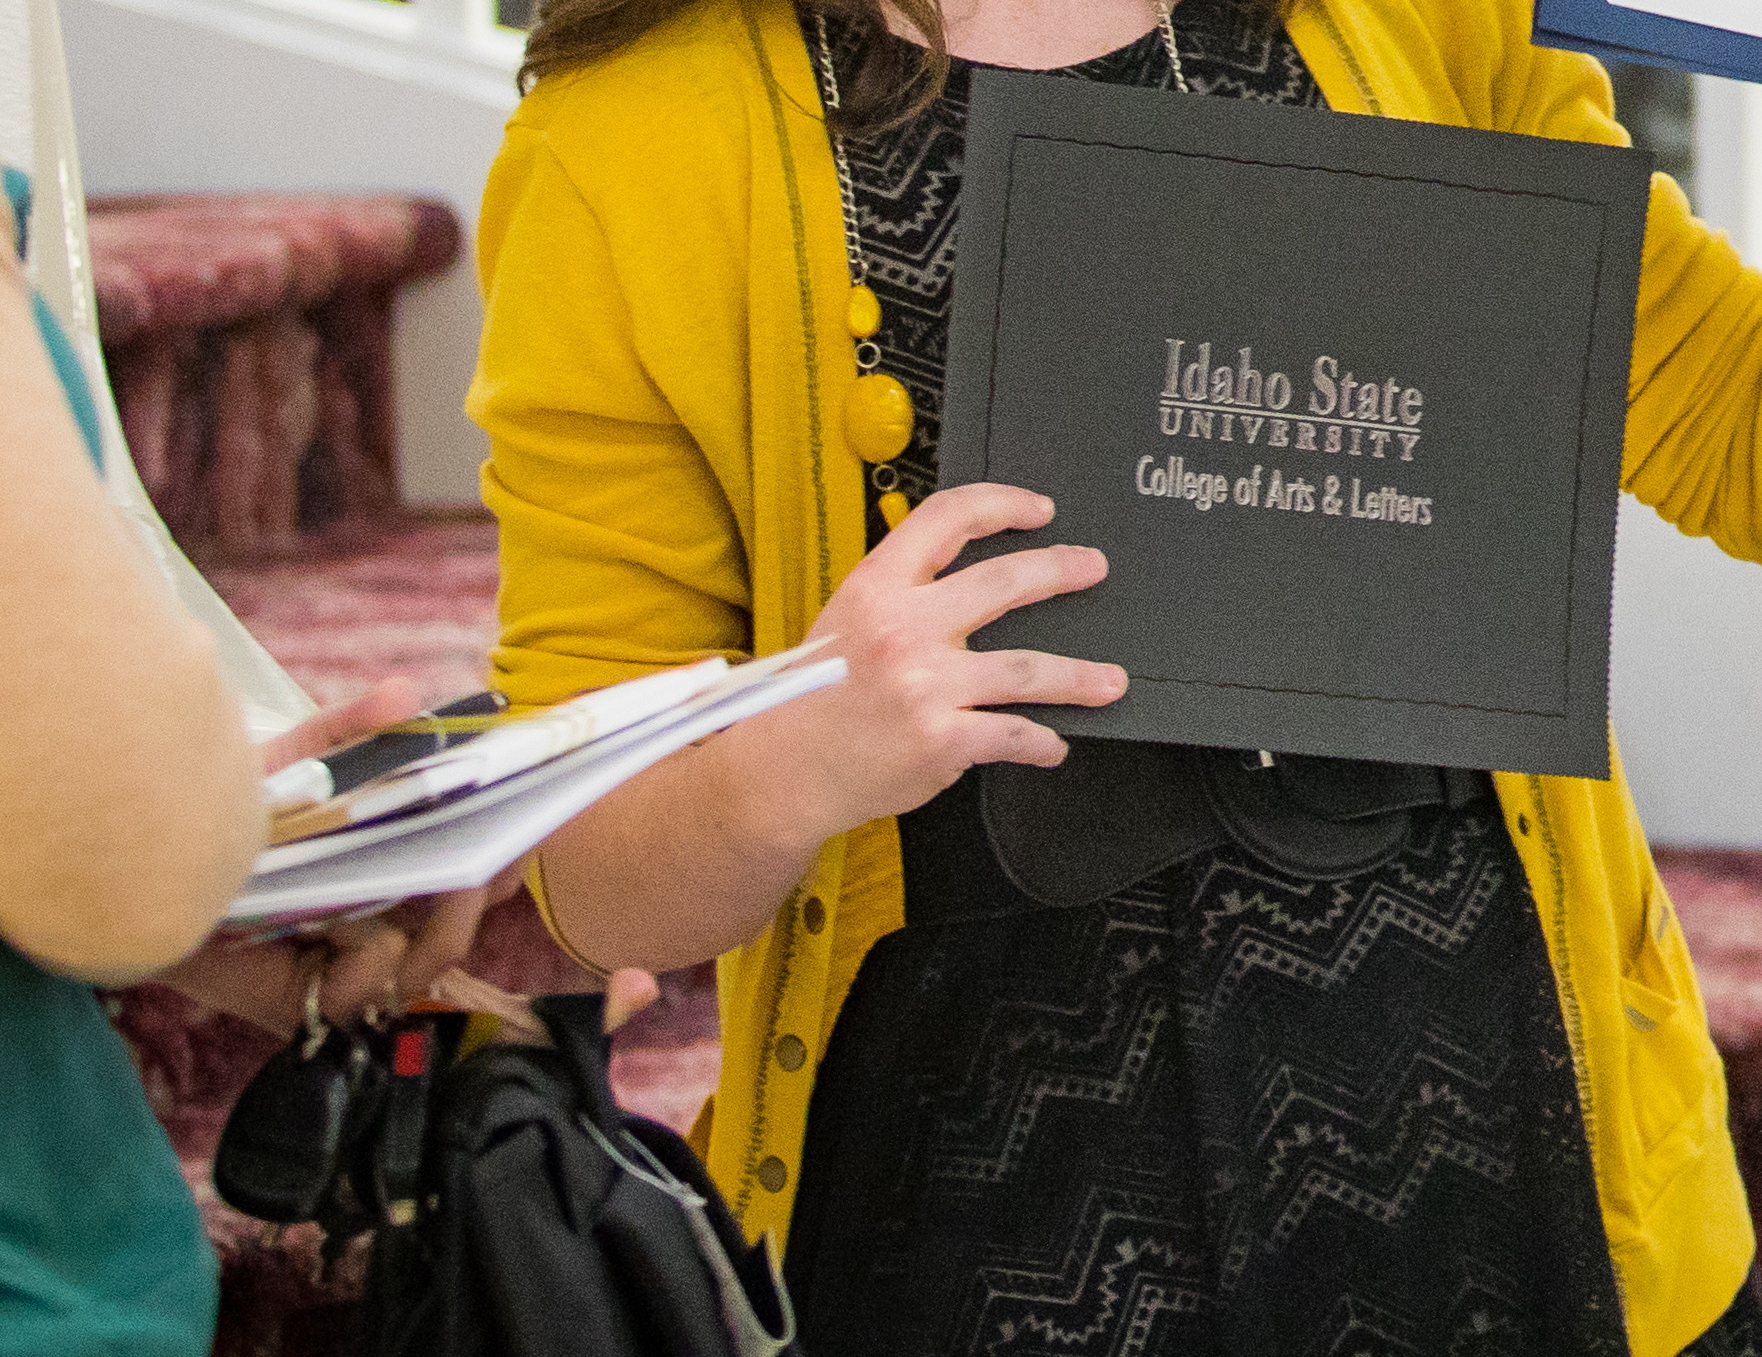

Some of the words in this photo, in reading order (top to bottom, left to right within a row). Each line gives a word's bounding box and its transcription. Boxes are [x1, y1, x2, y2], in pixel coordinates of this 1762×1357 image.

[1160, 338, 1292, 410] Idaho
[1309, 355, 1423, 425] State
[1158, 407, 1421, 461] UNIVERSITY
[1135, 455, 1228, 511] College
[1233, 464, 1263, 507] of
[1266, 469, 1315, 514] Arts
[1322, 475, 1342, 515] &
[1351, 478, 1433, 525] Letters
